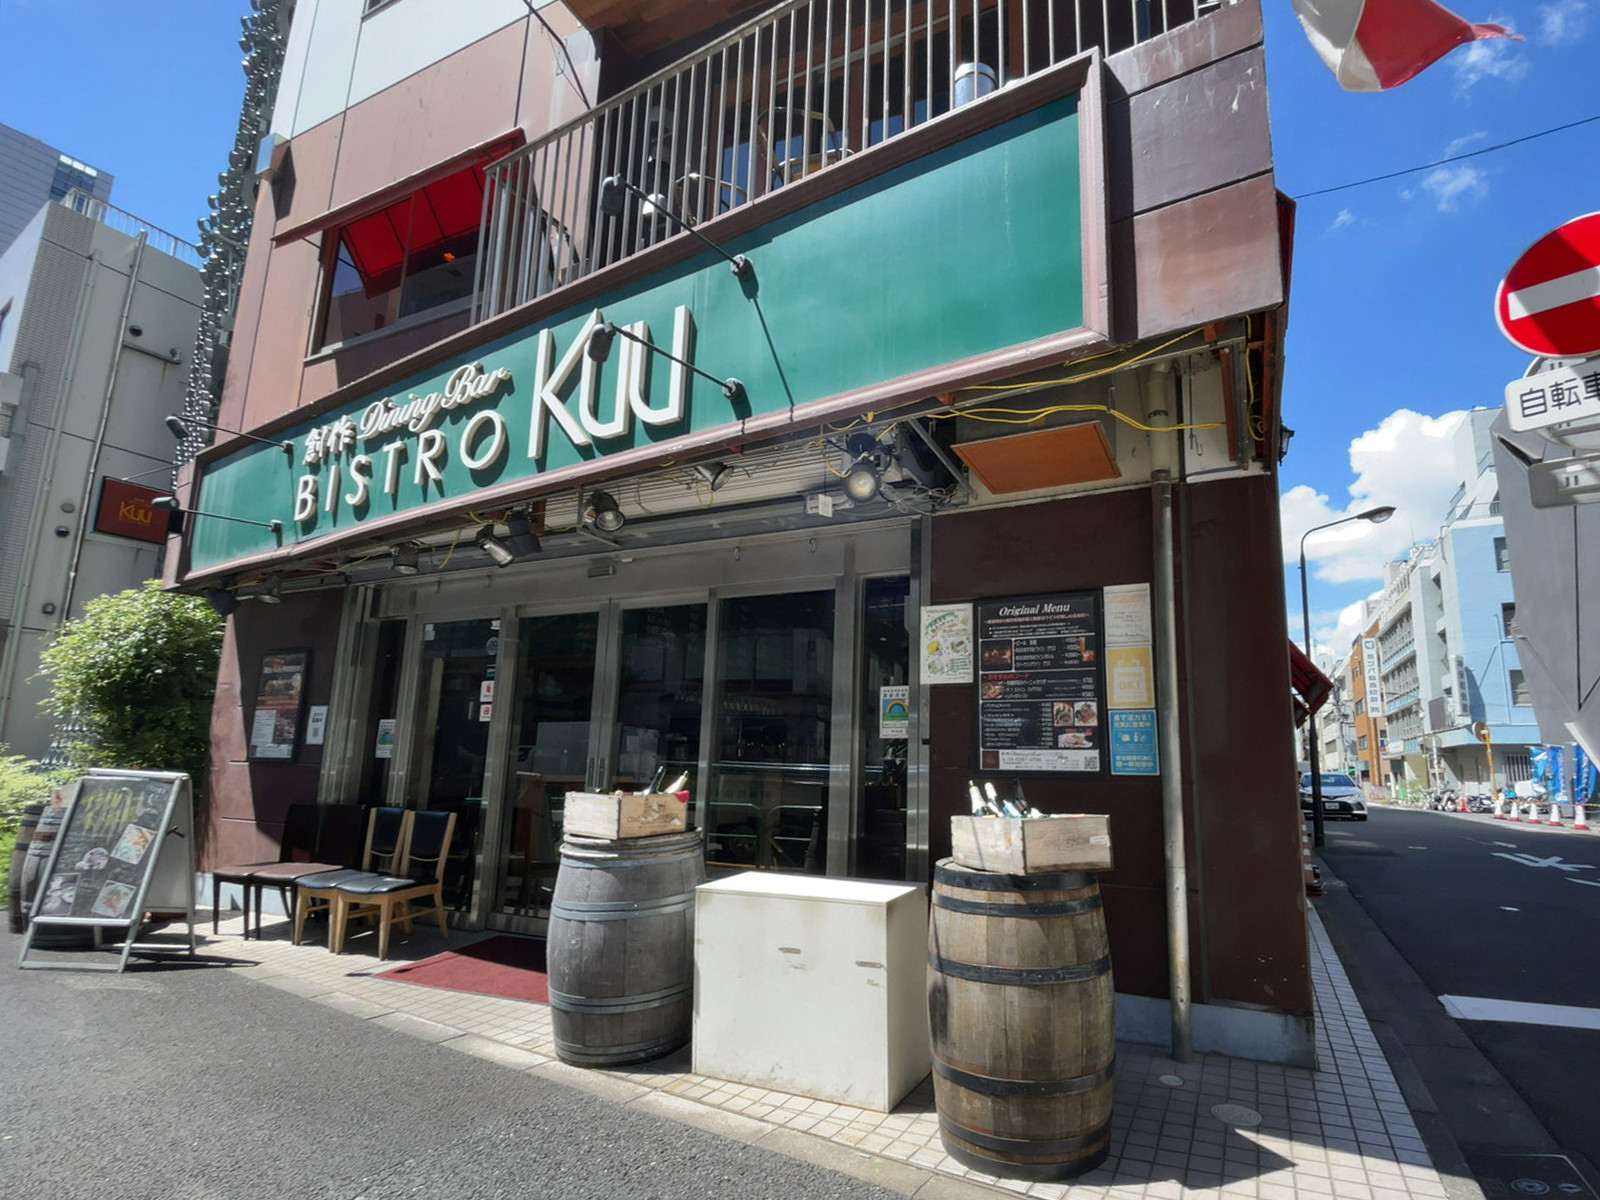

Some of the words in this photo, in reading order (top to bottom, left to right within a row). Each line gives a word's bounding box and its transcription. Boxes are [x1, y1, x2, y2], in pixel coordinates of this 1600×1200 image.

[294, 409, 508, 521] BISTRO
[527, 303, 691, 460] KUU
[303, 415, 357, 465] 創作
[357, 397, 444, 441] Dining
[441, 361, 512, 410] Bar
[999, 604, 1040, 616] Original
[1041, 603, 1070, 613] Menu
